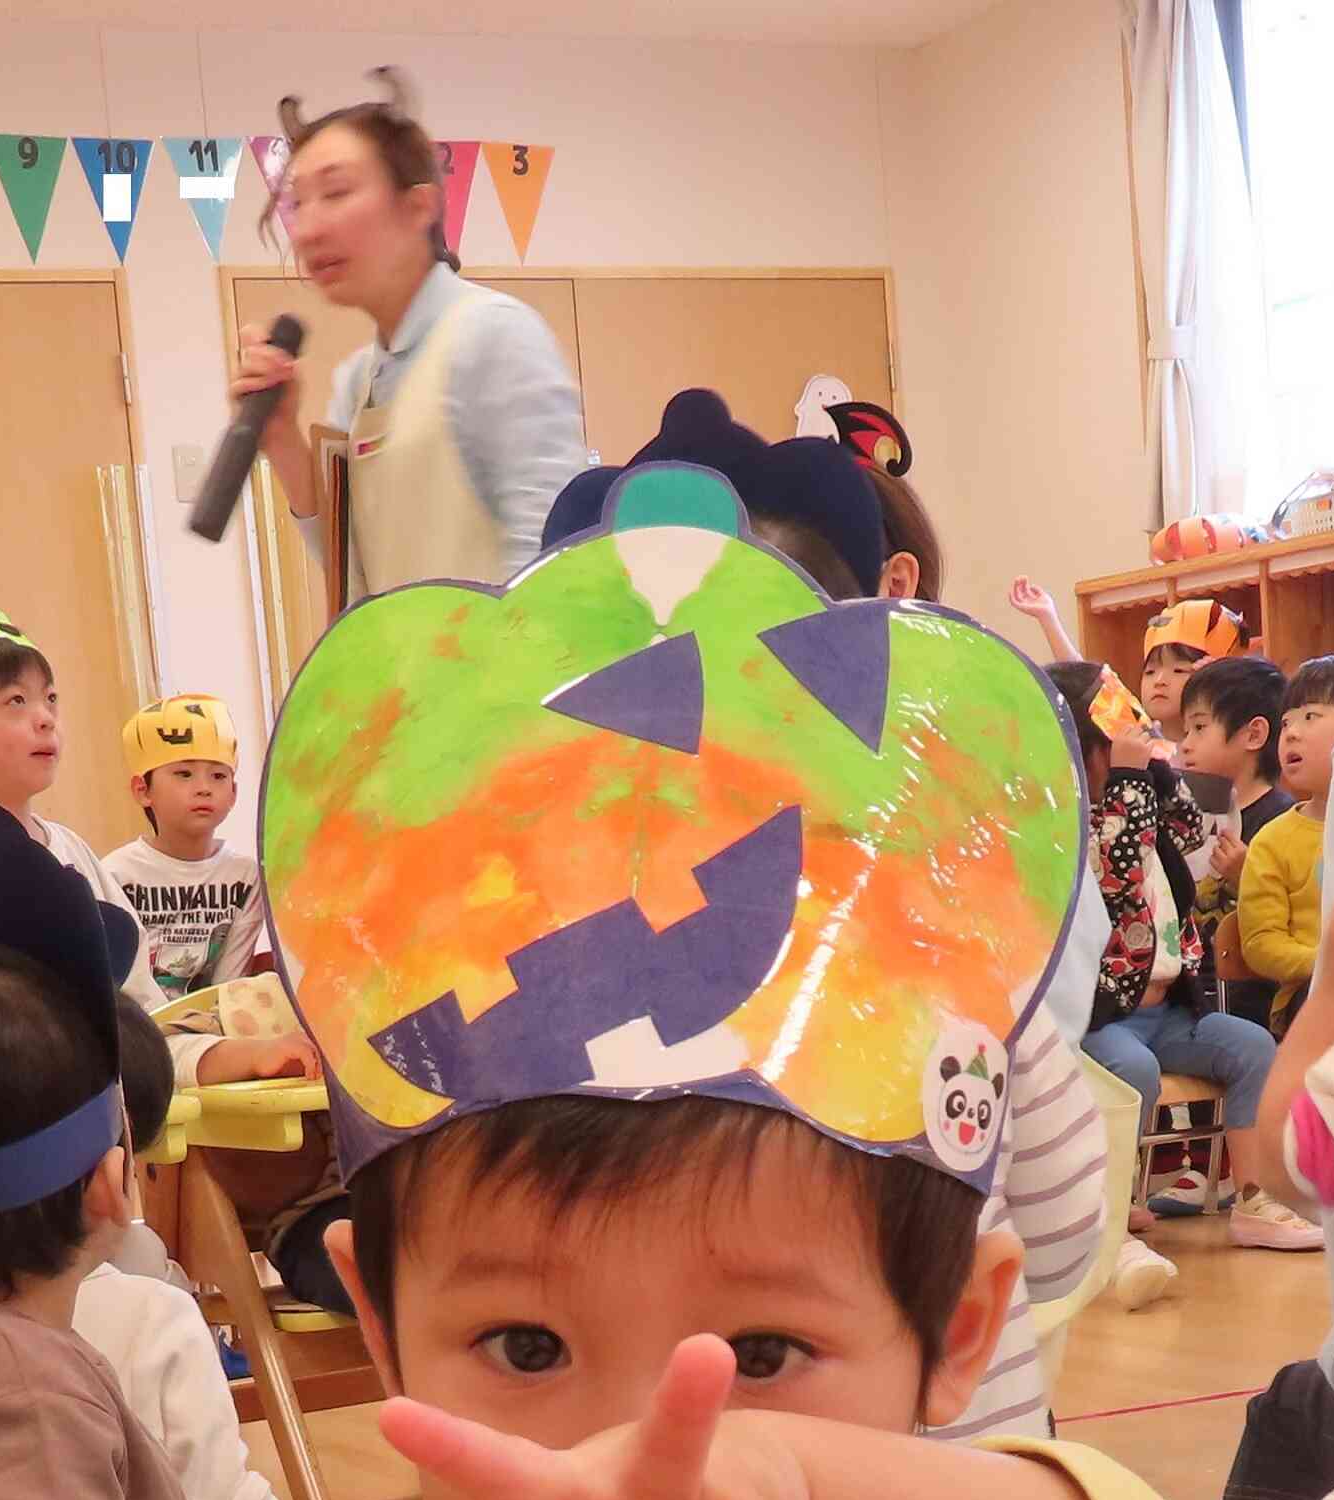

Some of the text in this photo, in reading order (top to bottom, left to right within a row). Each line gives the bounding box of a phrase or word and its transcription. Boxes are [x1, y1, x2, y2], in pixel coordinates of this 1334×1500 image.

[17, 137, 39, 169] 9
[97, 140, 138, 173] 10
[187, 139, 221, 172] 11
[511, 144, 530, 176] 3
[181, 910, 203, 925] THE
